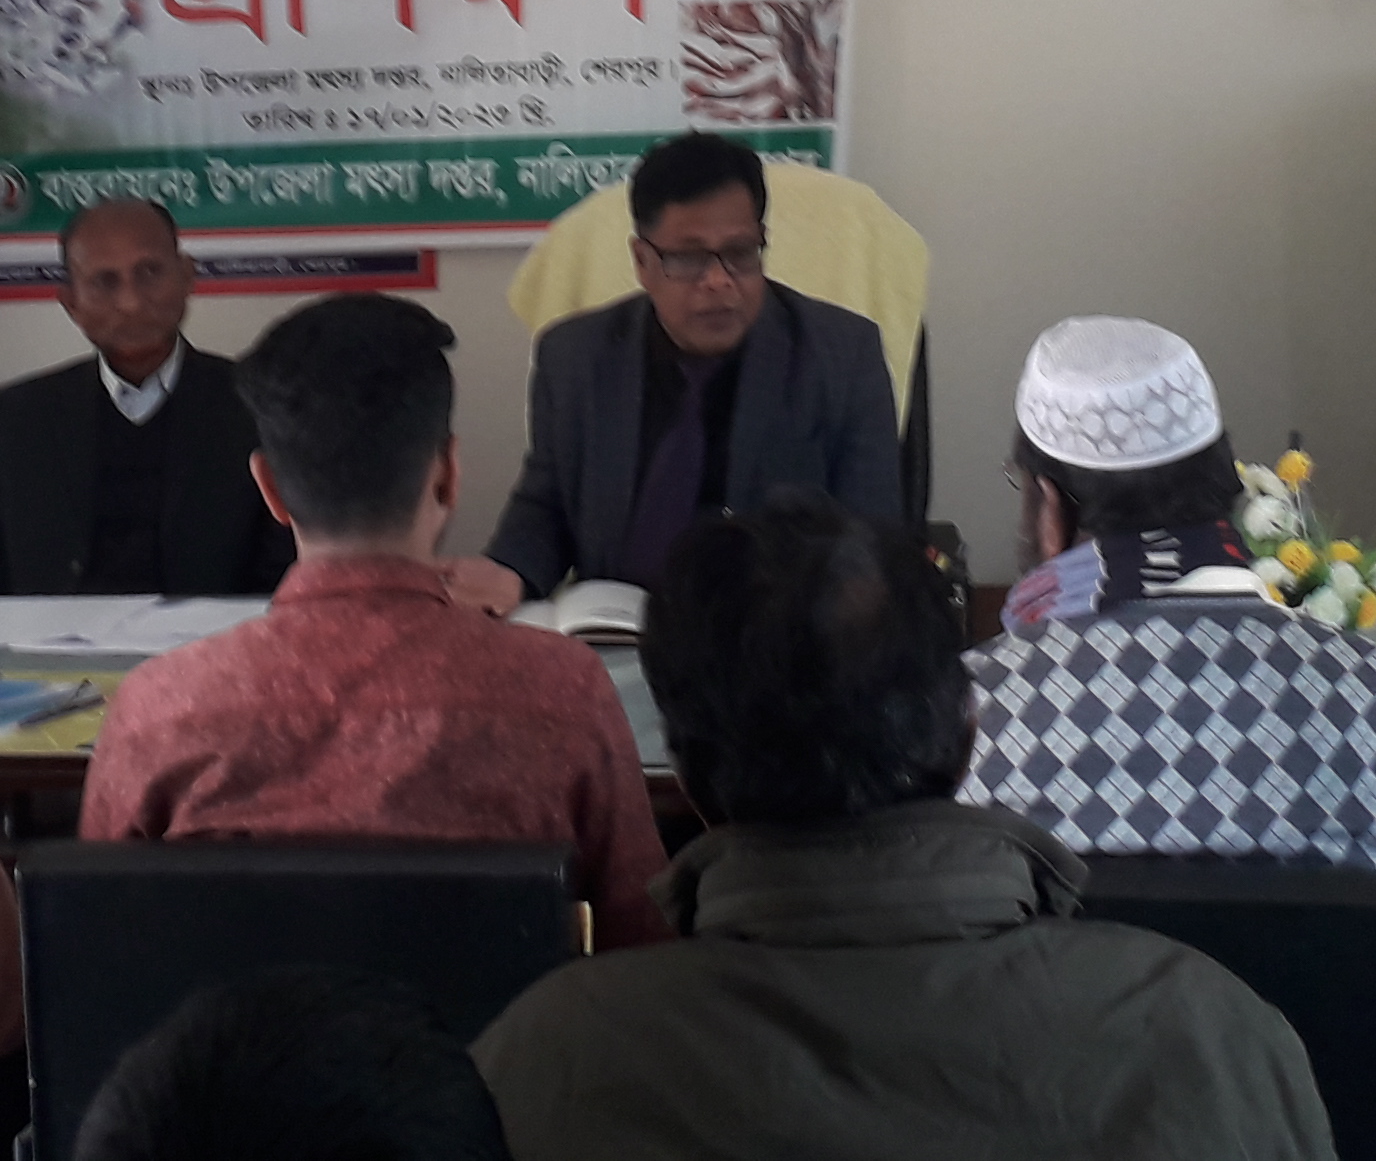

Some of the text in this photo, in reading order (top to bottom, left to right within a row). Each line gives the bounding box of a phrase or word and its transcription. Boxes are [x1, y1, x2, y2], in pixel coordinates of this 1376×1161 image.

[198, 66, 300, 96] উপজেলা
[201, 149, 336, 207] উপজেলা
[340, 158, 423, 204] মৎস্য
